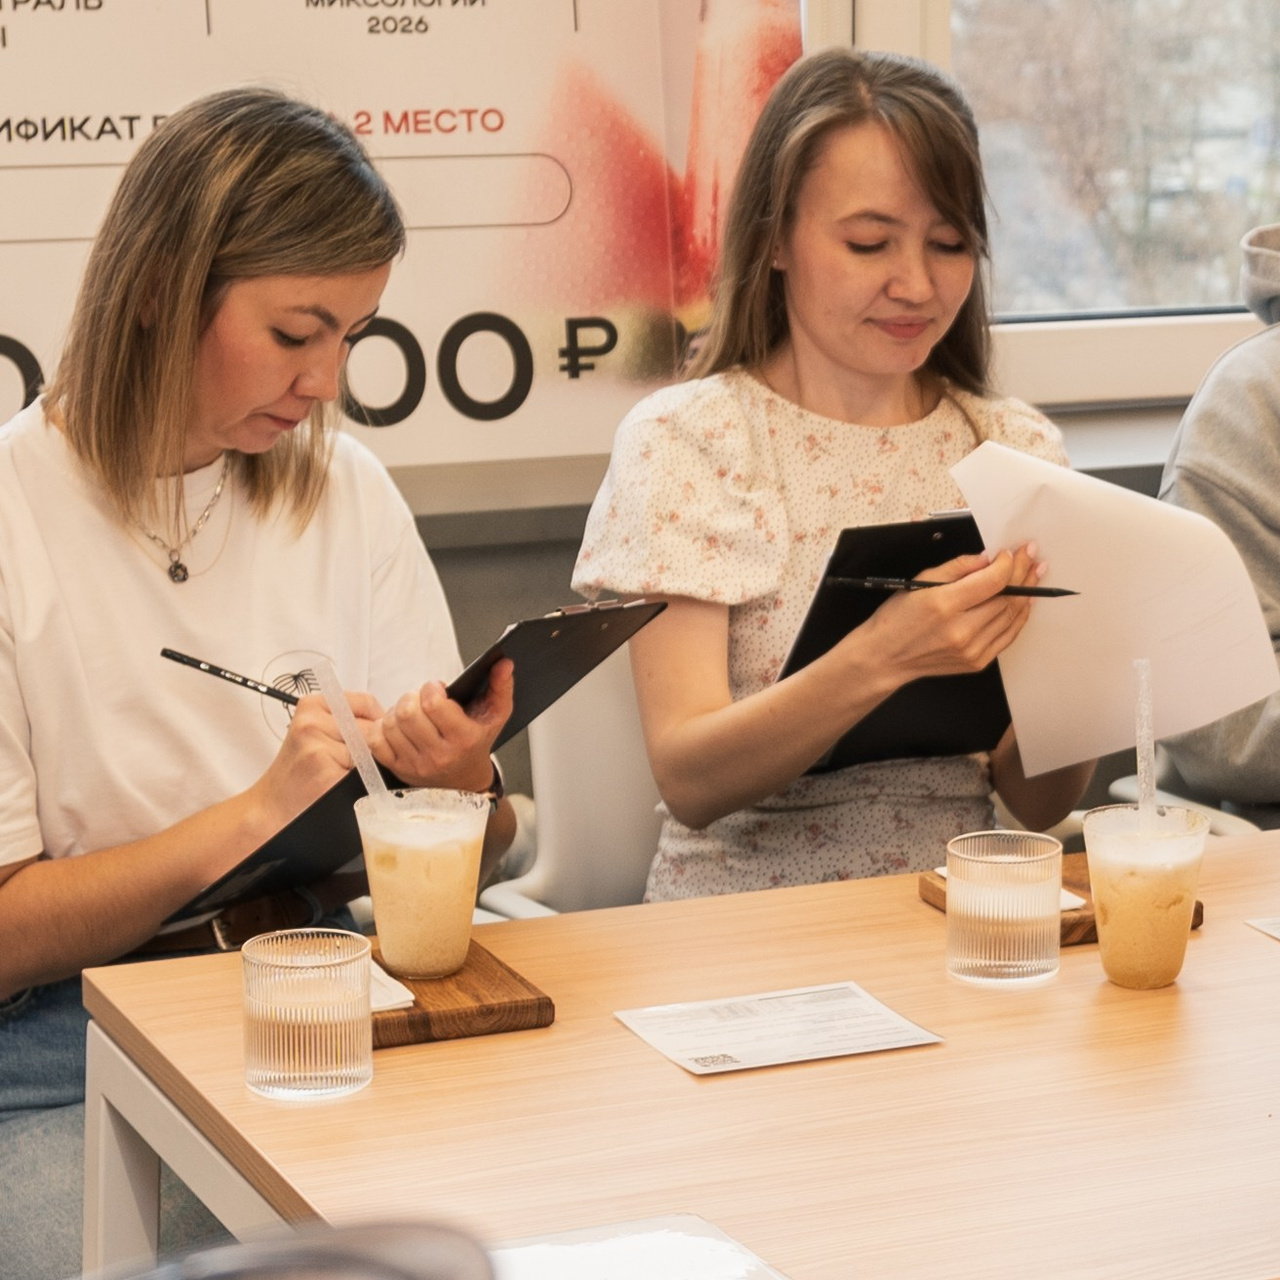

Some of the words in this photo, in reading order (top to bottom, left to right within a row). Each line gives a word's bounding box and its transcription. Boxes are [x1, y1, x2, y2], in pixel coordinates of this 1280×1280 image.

[367, 16, 429, 34] 2026
[354, 111, 373, 134] 2
[383, 109, 504, 134] МЕСТО
